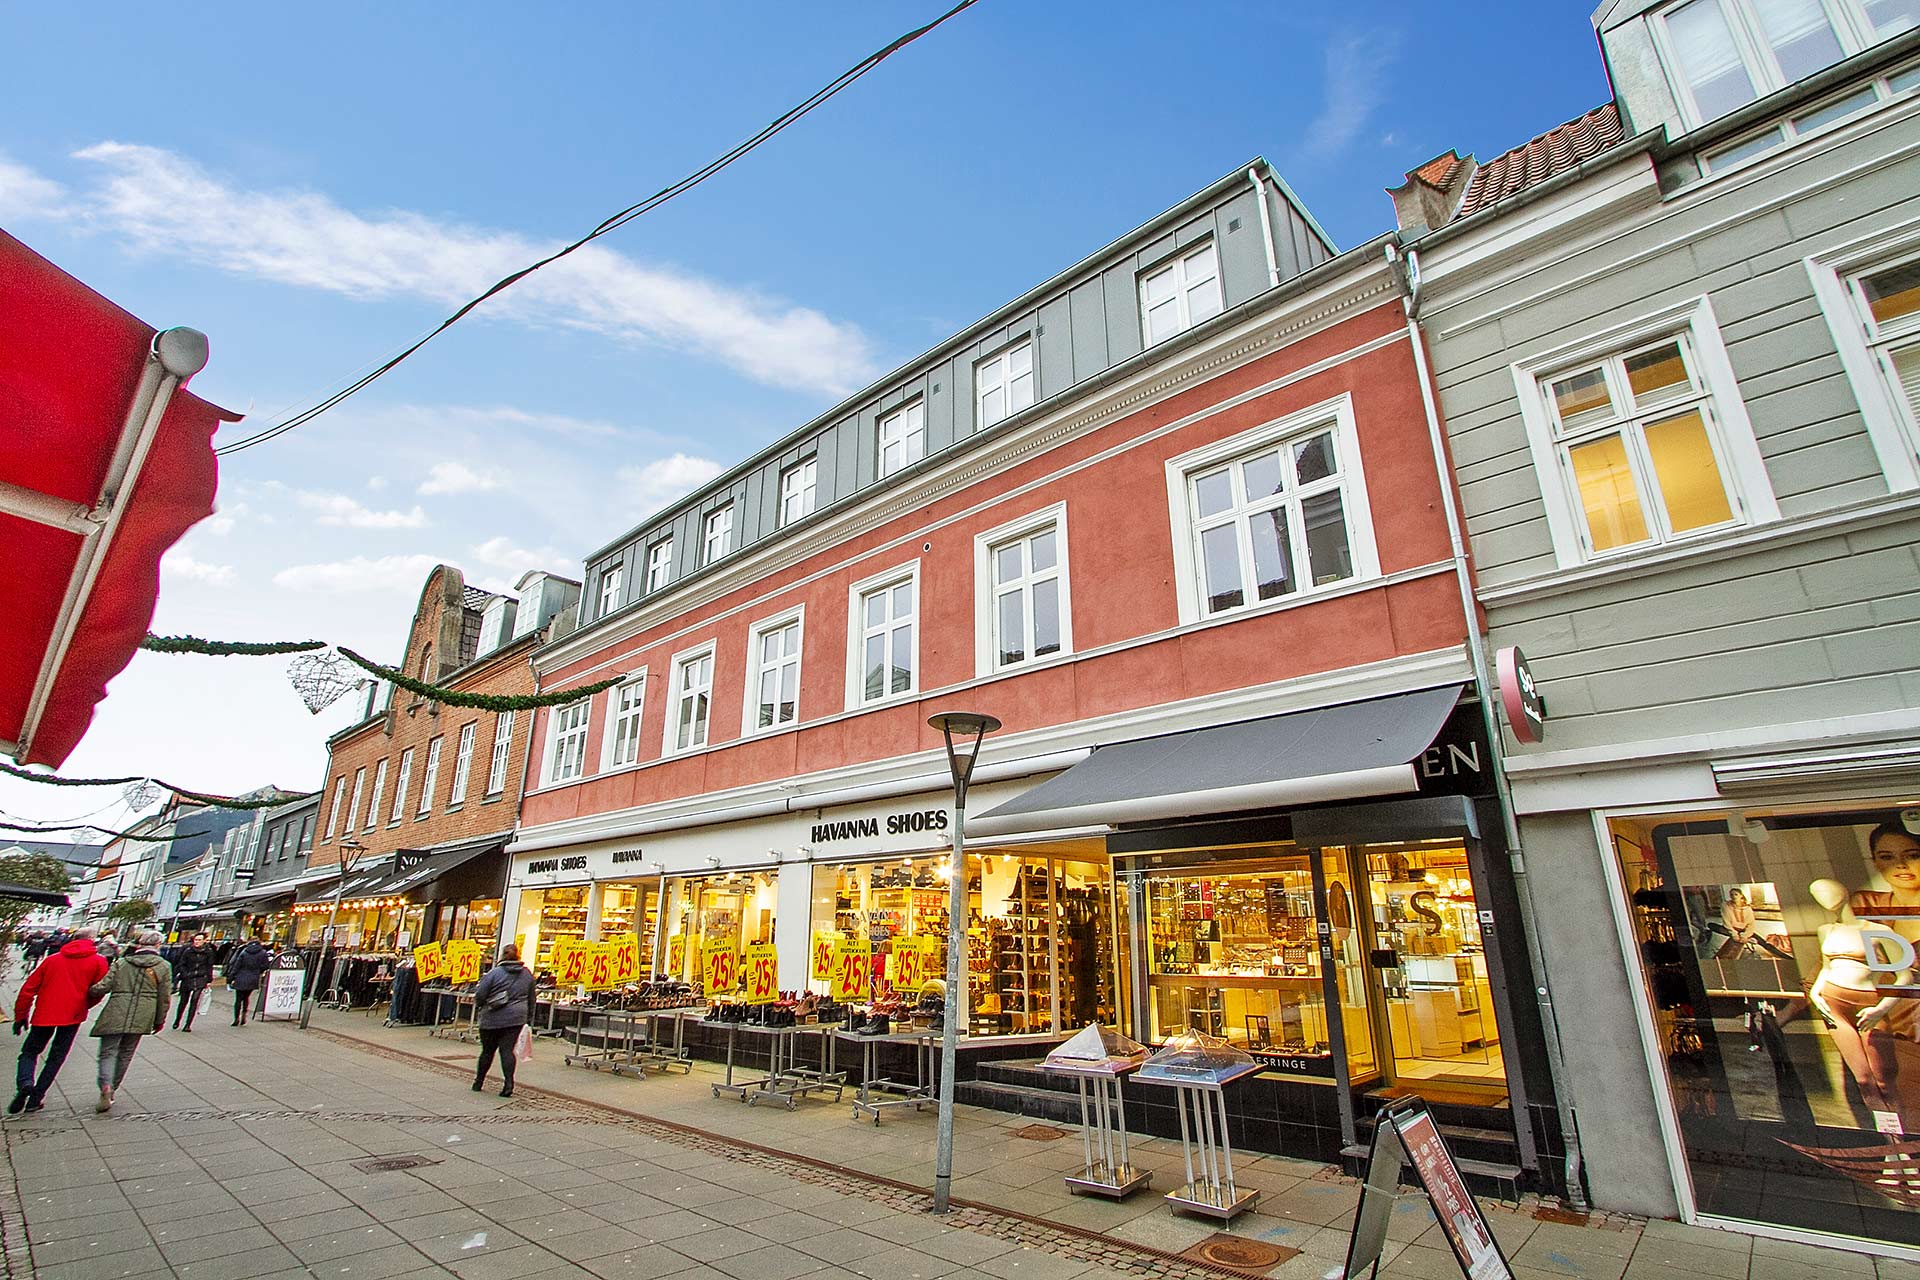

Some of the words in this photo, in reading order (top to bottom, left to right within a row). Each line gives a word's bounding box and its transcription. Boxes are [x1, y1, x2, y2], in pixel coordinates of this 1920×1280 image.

[811, 817, 879, 843] HAVANNA
[886, 809, 948, 835] SHOES
[528, 858, 559, 875] HAVANNA
[560, 855, 588, 871] SHOES
[565, 951, 587, 980] 25%
[617, 945, 638, 977] 25%
[708, 946, 732, 954] BUTIKKEN
[898, 949, 921, 986] 25%
[1860, 930, 1916, 972] D
[711, 952, 735, 990] 25%
[755, 958, 777, 997] 25%
[842, 954, 869, 996] 25%
